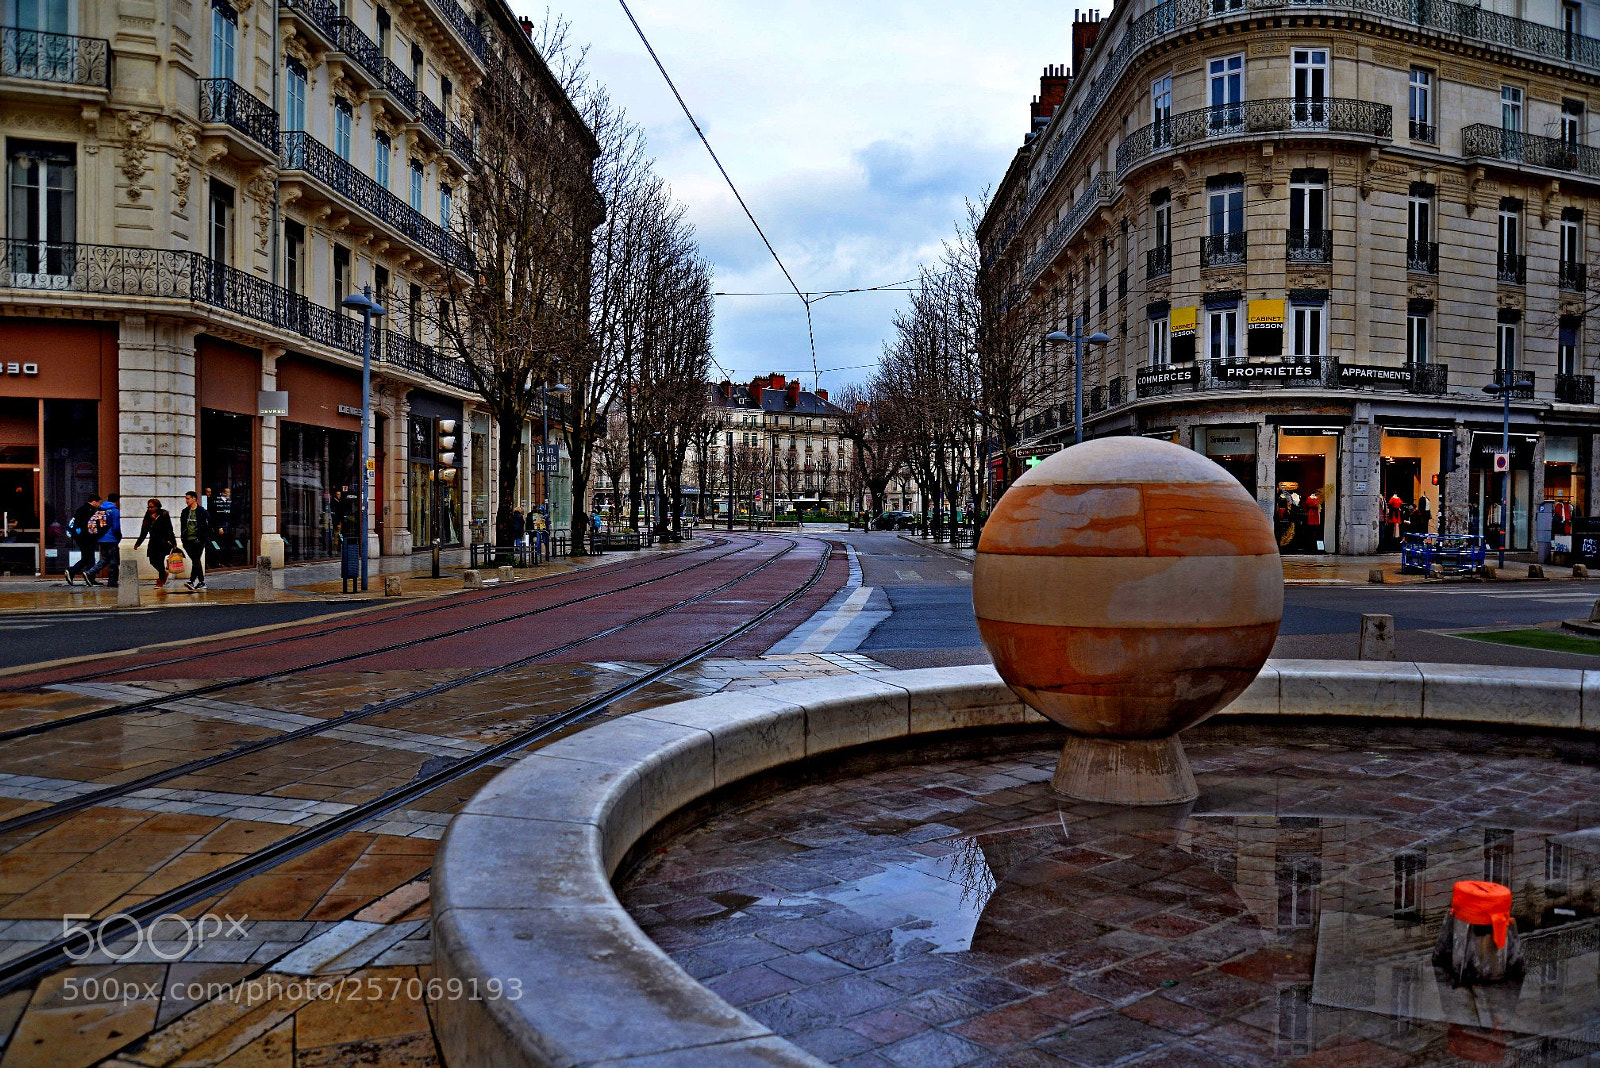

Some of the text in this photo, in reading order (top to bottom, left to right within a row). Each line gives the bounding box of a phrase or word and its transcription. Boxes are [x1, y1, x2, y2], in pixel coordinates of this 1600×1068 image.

[1171, 323, 1195, 331] CABINET
[1227, 365, 1312, 377] PROPRIÉTÉS
[1341, 367, 1411, 381] APPARTEMENTS
[1137, 371, 1192, 384] COMMERCES
[537, 445, 554, 454] Jen
